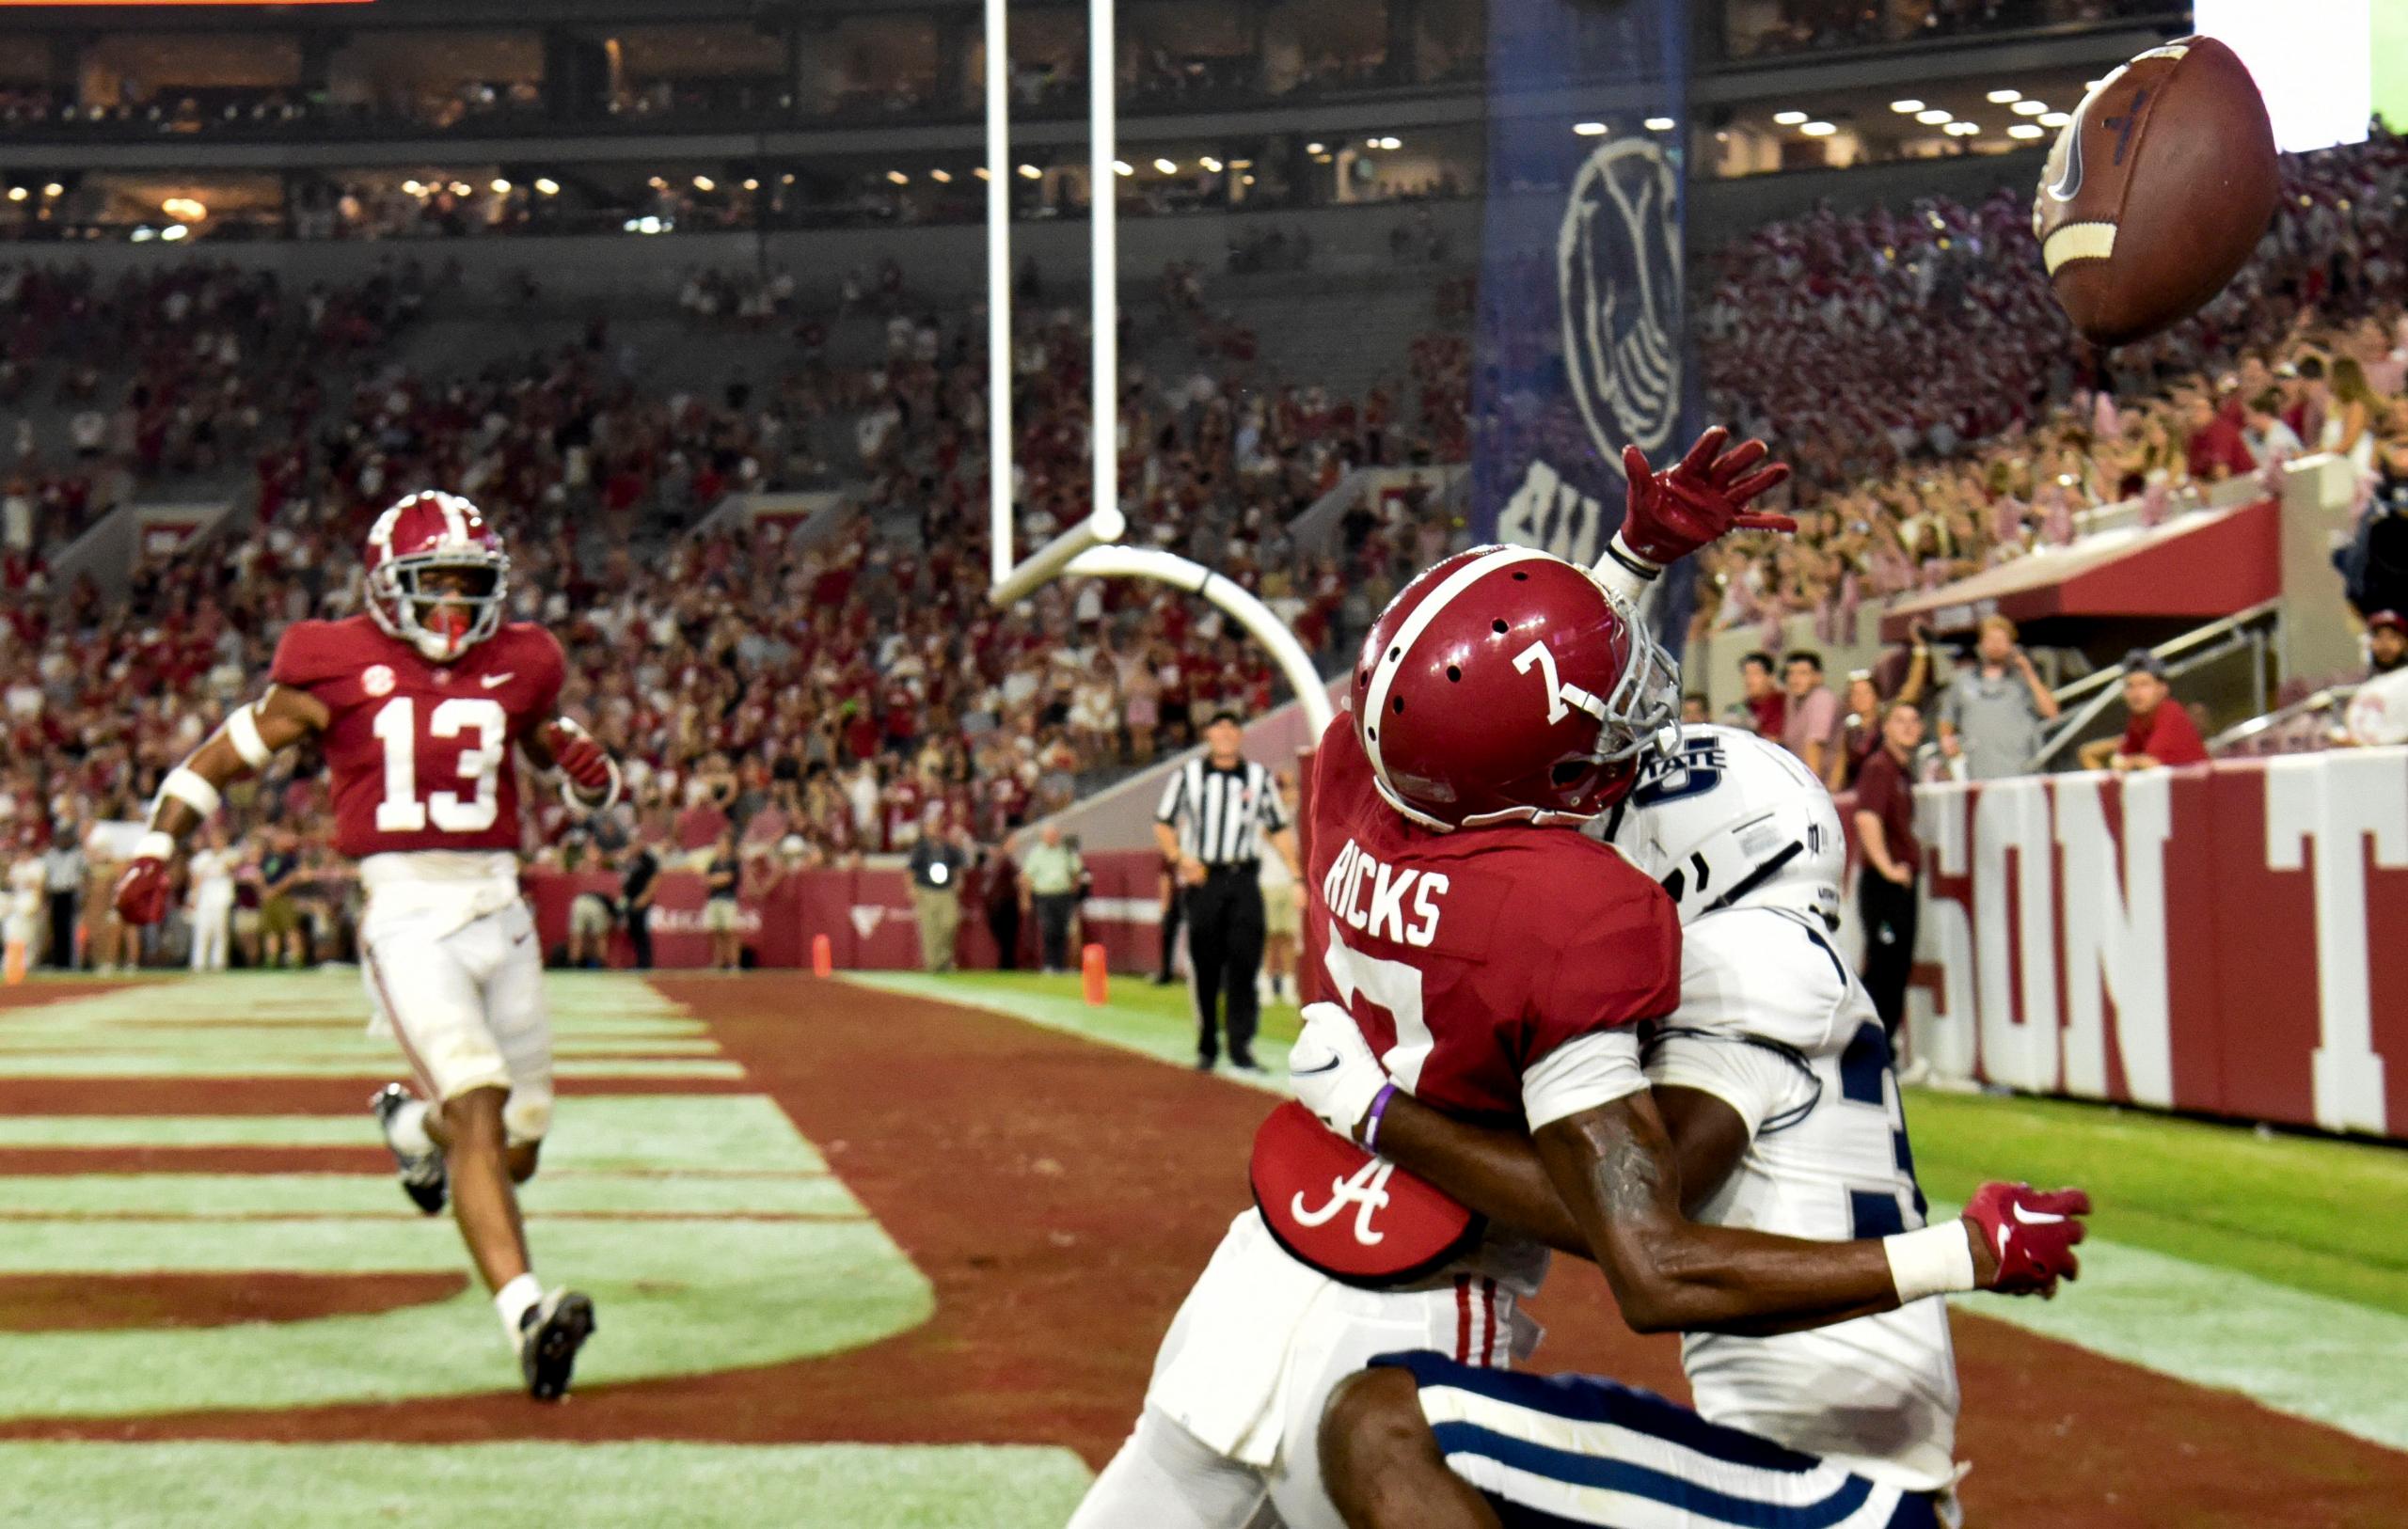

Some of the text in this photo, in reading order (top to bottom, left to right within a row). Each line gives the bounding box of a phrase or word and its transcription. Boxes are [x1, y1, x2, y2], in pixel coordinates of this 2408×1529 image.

[1512, 639, 1569, 726] 7
[372, 696, 507, 831] 13
[1323, 838, 1450, 947] RICKS
